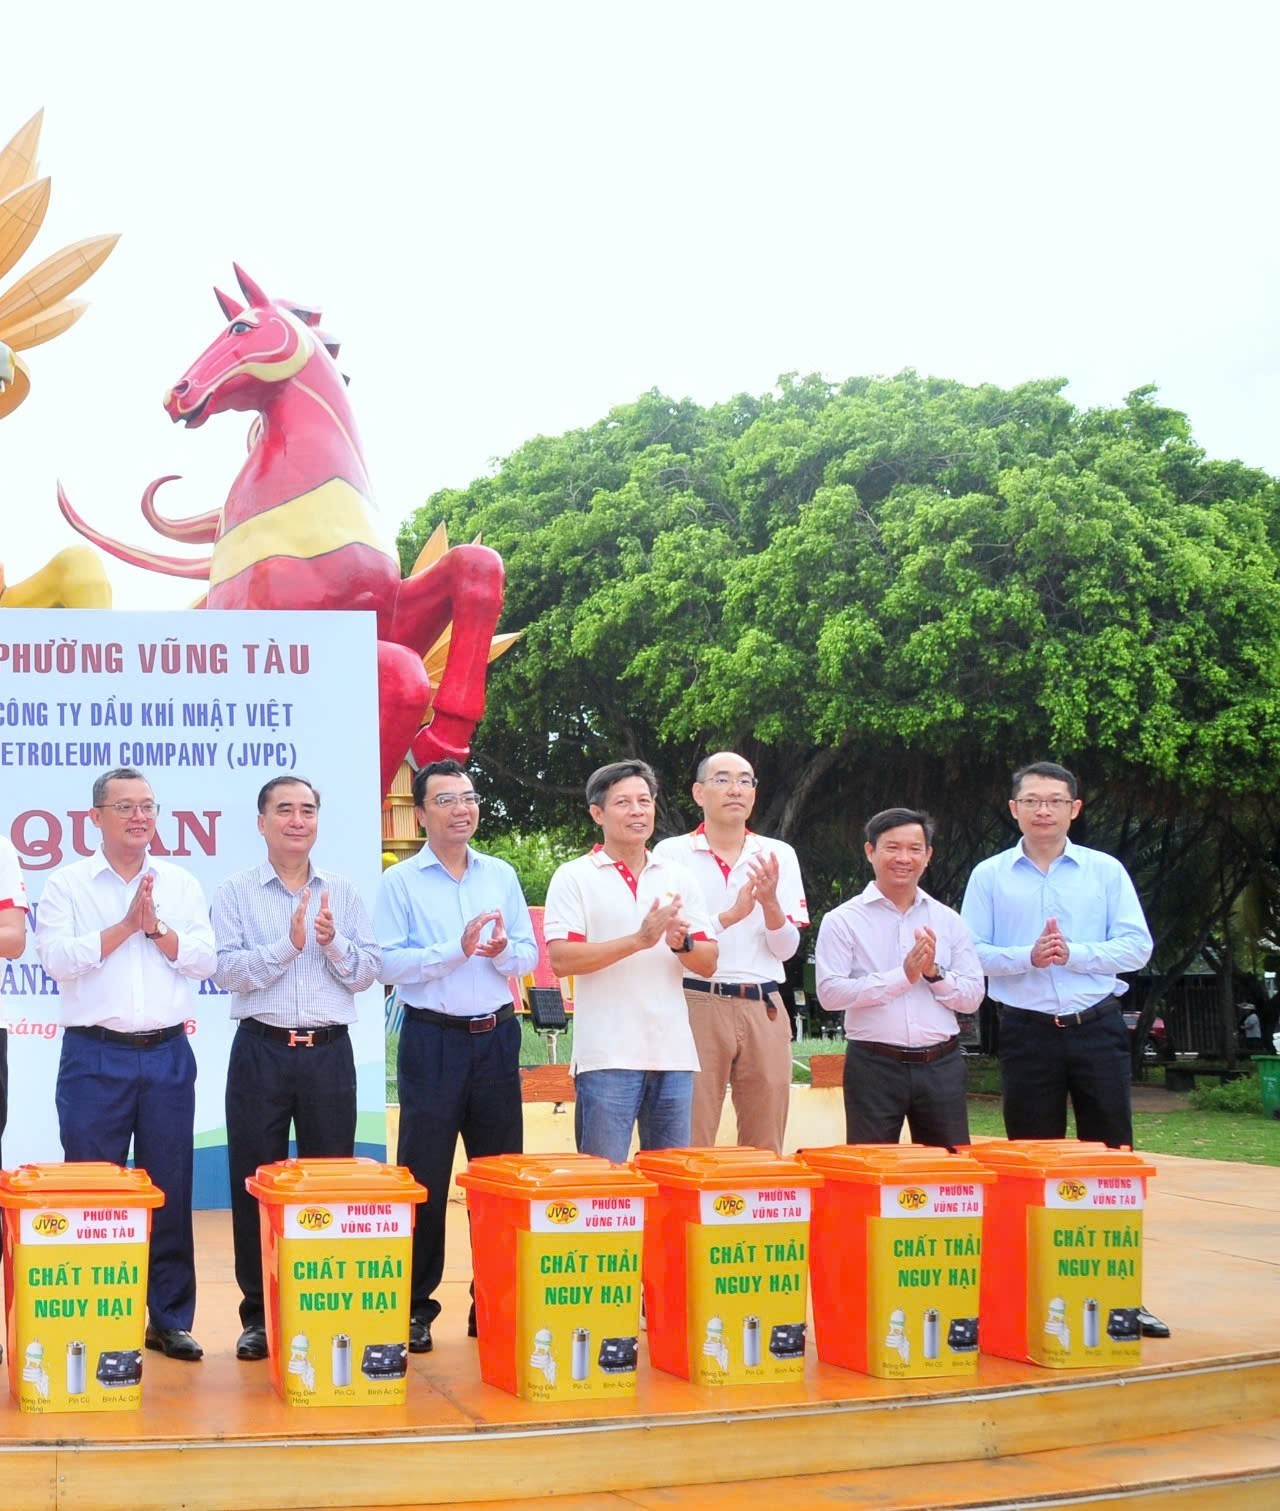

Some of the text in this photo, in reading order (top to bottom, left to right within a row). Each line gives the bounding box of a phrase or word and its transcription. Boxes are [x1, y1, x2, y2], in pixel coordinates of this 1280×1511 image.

[138, 637, 229, 674] VŨNG
[242, 638, 311, 675] TÀU
[56, 702, 82, 727] TY
[90, 695, 133, 727] DẦU
[141, 698, 174, 727] KHÍ
[182, 699, 237, 732] NHẬT
[246, 699, 294, 732] VIỆT
[119, 742, 218, 767] COMPANY
[226, 742, 298, 769] (JVPC)
[758, 1189, 796, 1202] PHƯỜNG
[899, 1193, 927, 1205] JVPC
[1059, 1185, 1086, 1196] JVPC
[347, 1203, 392, 1216] PHƯỜNG
[548, 1207, 577, 1218] JVPC
[591, 1198, 631, 1210] PHƯỜNG
[715, 1199, 744, 1211] JVPC
[752, 1205, 802, 1219] VŨNG TÀU
[933, 1200, 979, 1213] VŨNG TÀU
[83, 1209, 128, 1221] PHƯỜNG
[299, 1213, 331, 1224] JVPC
[585, 1215, 636, 1227] VŨNG TÀU
[35, 1218, 66, 1230] JVPC
[76, 1225, 135, 1239] VŨNG TÀU
[341, 1220, 399, 1233] VŨNG TÀU
[893, 1233, 980, 1257] CHẤT THẢI
[1053, 1225, 1139, 1248] CHẤT THẢI
[710, 1238, 805, 1265] CHẤT THẢI
[293, 1255, 403, 1280] CHẤT THẢI
[540, 1248, 638, 1274] CHẤT THẢI
[1058, 1259, 1135, 1280] NGUY HẠI
[28, 1260, 138, 1287] CHẤT THẢI
[898, 1268, 977, 1289] NGUY HẠI
[715, 1273, 800, 1295] NGUY HẠI
[300, 1291, 397, 1313] NGUY HẠI
[545, 1285, 632, 1307] NGUY HẠI
[35, 1298, 132, 1320] NGUY HẠI
